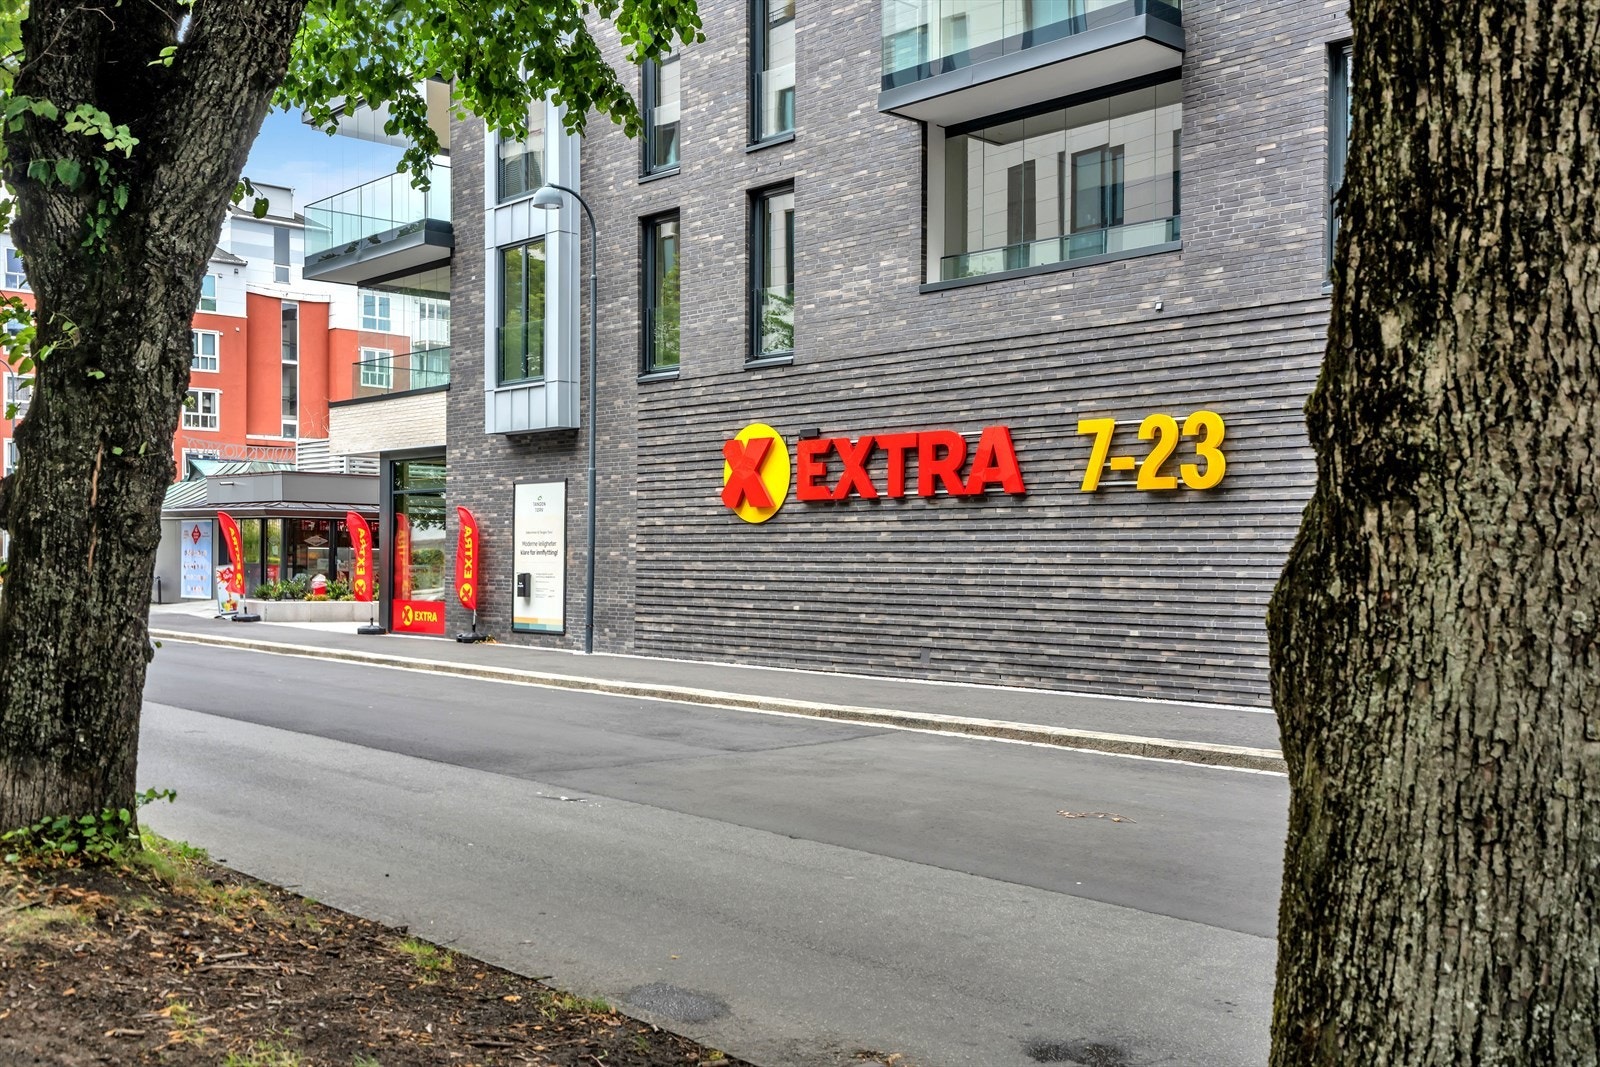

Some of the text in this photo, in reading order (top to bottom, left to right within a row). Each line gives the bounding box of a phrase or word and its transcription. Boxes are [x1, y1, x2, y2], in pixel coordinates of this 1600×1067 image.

[796, 425, 1026, 501] EXTRA
[1077, 410, 1226, 493] 7-23
[414, 611, 438, 622] EXTRA
